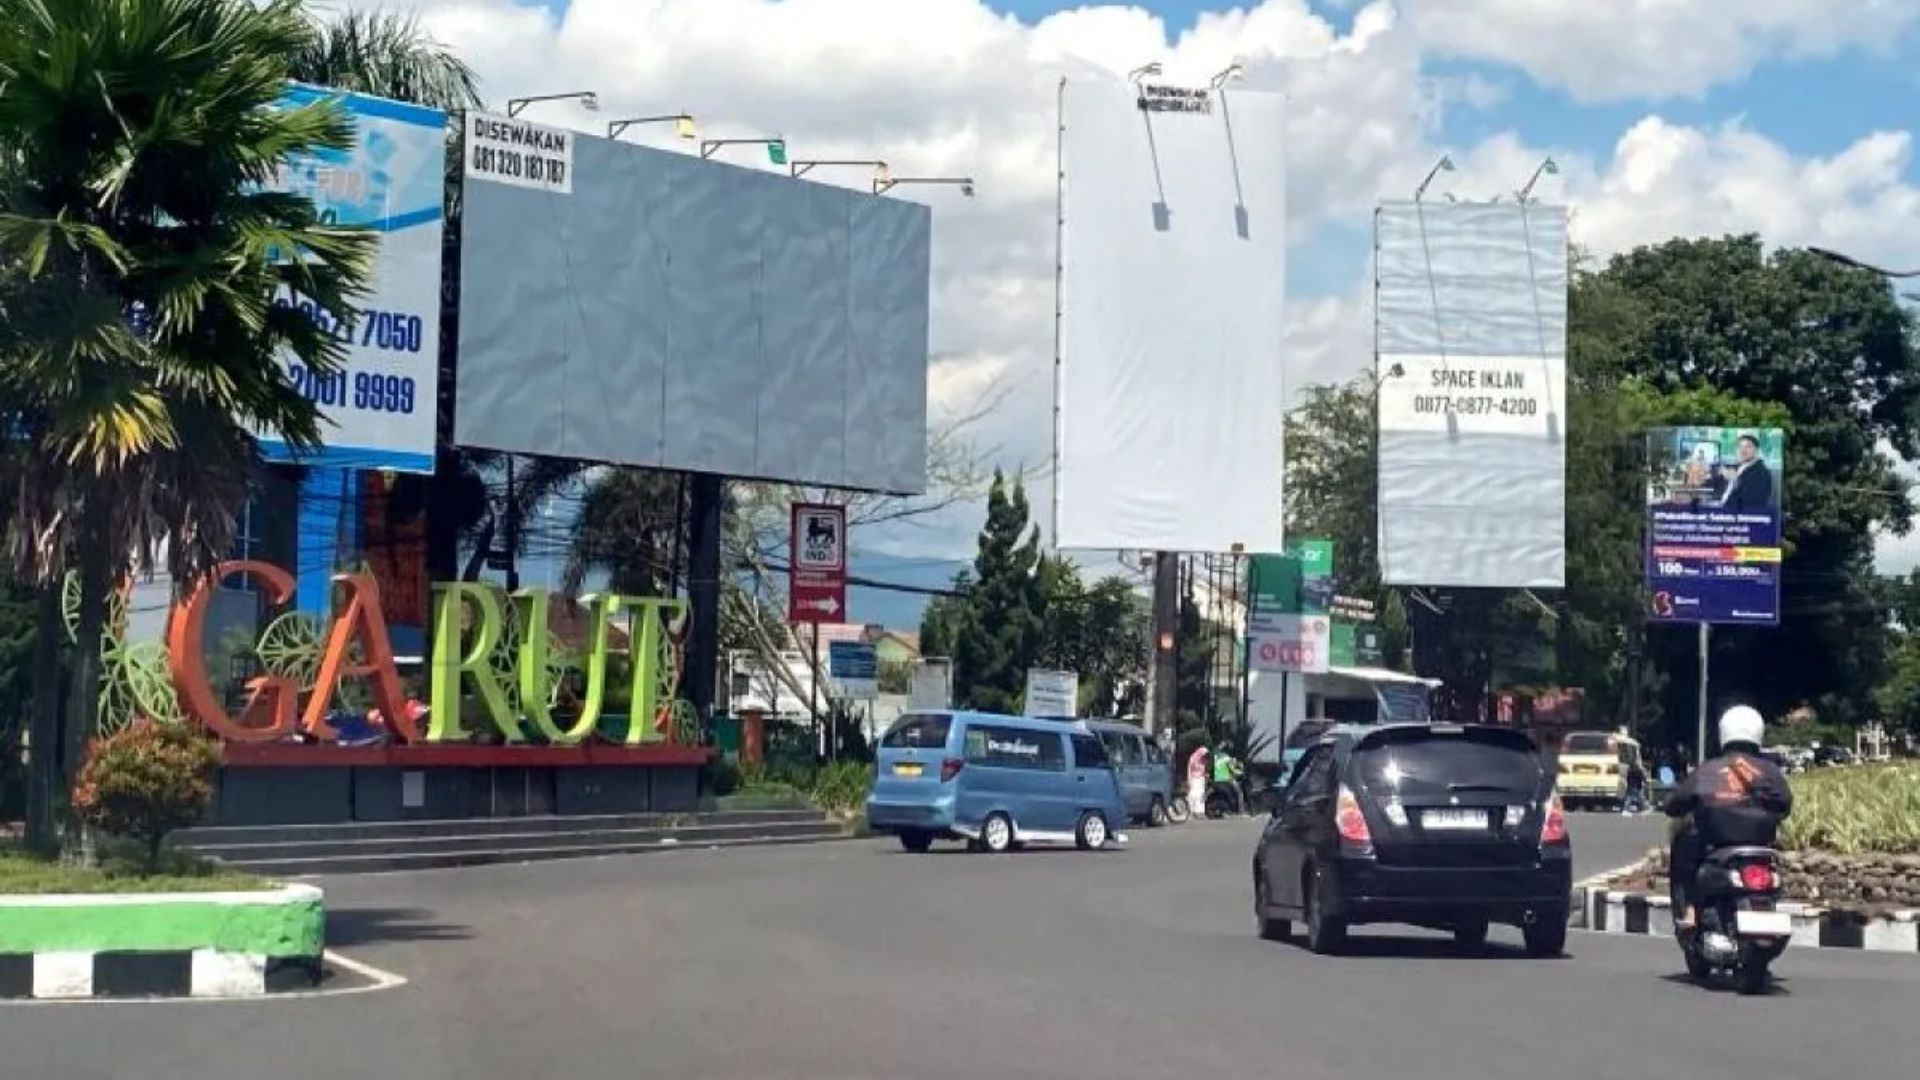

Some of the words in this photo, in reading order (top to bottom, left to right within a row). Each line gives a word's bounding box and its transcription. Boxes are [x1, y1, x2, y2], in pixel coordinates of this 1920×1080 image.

[474, 118, 565, 153] DISEWAKAN
[498, 149, 521, 178] 320
[362, 308, 422, 353] 7050
[354, 372, 415, 414] 9999
[1431, 369, 1477, 389] SPACE
[1480, 370, 1525, 390] IKLAN
[1414, 394, 1537, 417] 0877-0877-4200
[1658, 562, 1683, 576] 100
[167, 560, 691, 743] GARUT
